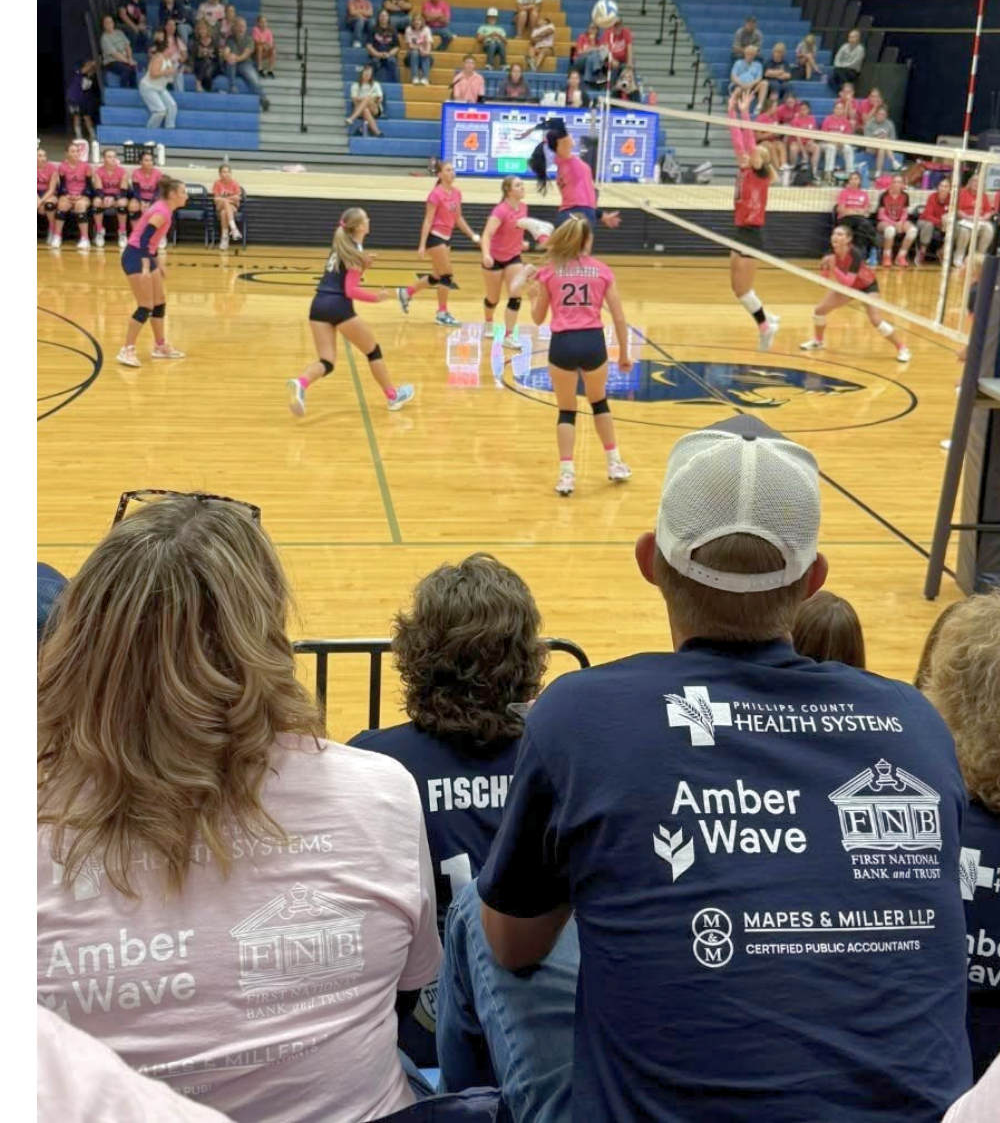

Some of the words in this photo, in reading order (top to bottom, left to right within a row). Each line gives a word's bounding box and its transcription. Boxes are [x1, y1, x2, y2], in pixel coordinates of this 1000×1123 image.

[463, 132, 479, 151] 4
[620, 137, 637, 156] 4
[561, 283, 592, 307] 21
[733, 701, 795, 713] PHILLIPS
[801, 703, 855, 713] COUNTY
[734, 714, 817, 733] HEALTH
[820, 715, 904, 733] SYSTEMS
[427, 774, 514, 812] FISCH
[671, 780, 801, 815] Amber
[845, 809, 937, 834] FNB
[698, 819, 807, 854] Wave
[232, 834, 334, 860] SYSTEMS
[851, 854, 886, 866] FIRST
[888, 854, 940, 866] NATIONAL
[853, 868, 890, 879] BANK
[893, 868, 911, 879] and
[913, 868, 941, 879] TRUST
[703, 914, 721, 928] M
[743, 911, 812, 928] MAPES
[820, 912, 833, 927] &
[838, 910, 905, 927] MILLER
[909, 909, 936, 925] LLP
[46, 928, 195, 978] Amber
[250, 932, 358, 970] FNB
[704, 947, 723, 962] M
[745, 943, 803, 955] CERTIFIED
[805, 942, 845, 954] PUBLIC
[847, 940, 921, 953] ACCOUNTANTS
[71, 972, 196, 1014] Wave
[247, 988, 286, 1005] FIRST
[246, 1002, 286, 1020] BANK
[292, 996, 315, 1013] and
[318, 986, 361, 1007] TRUST
